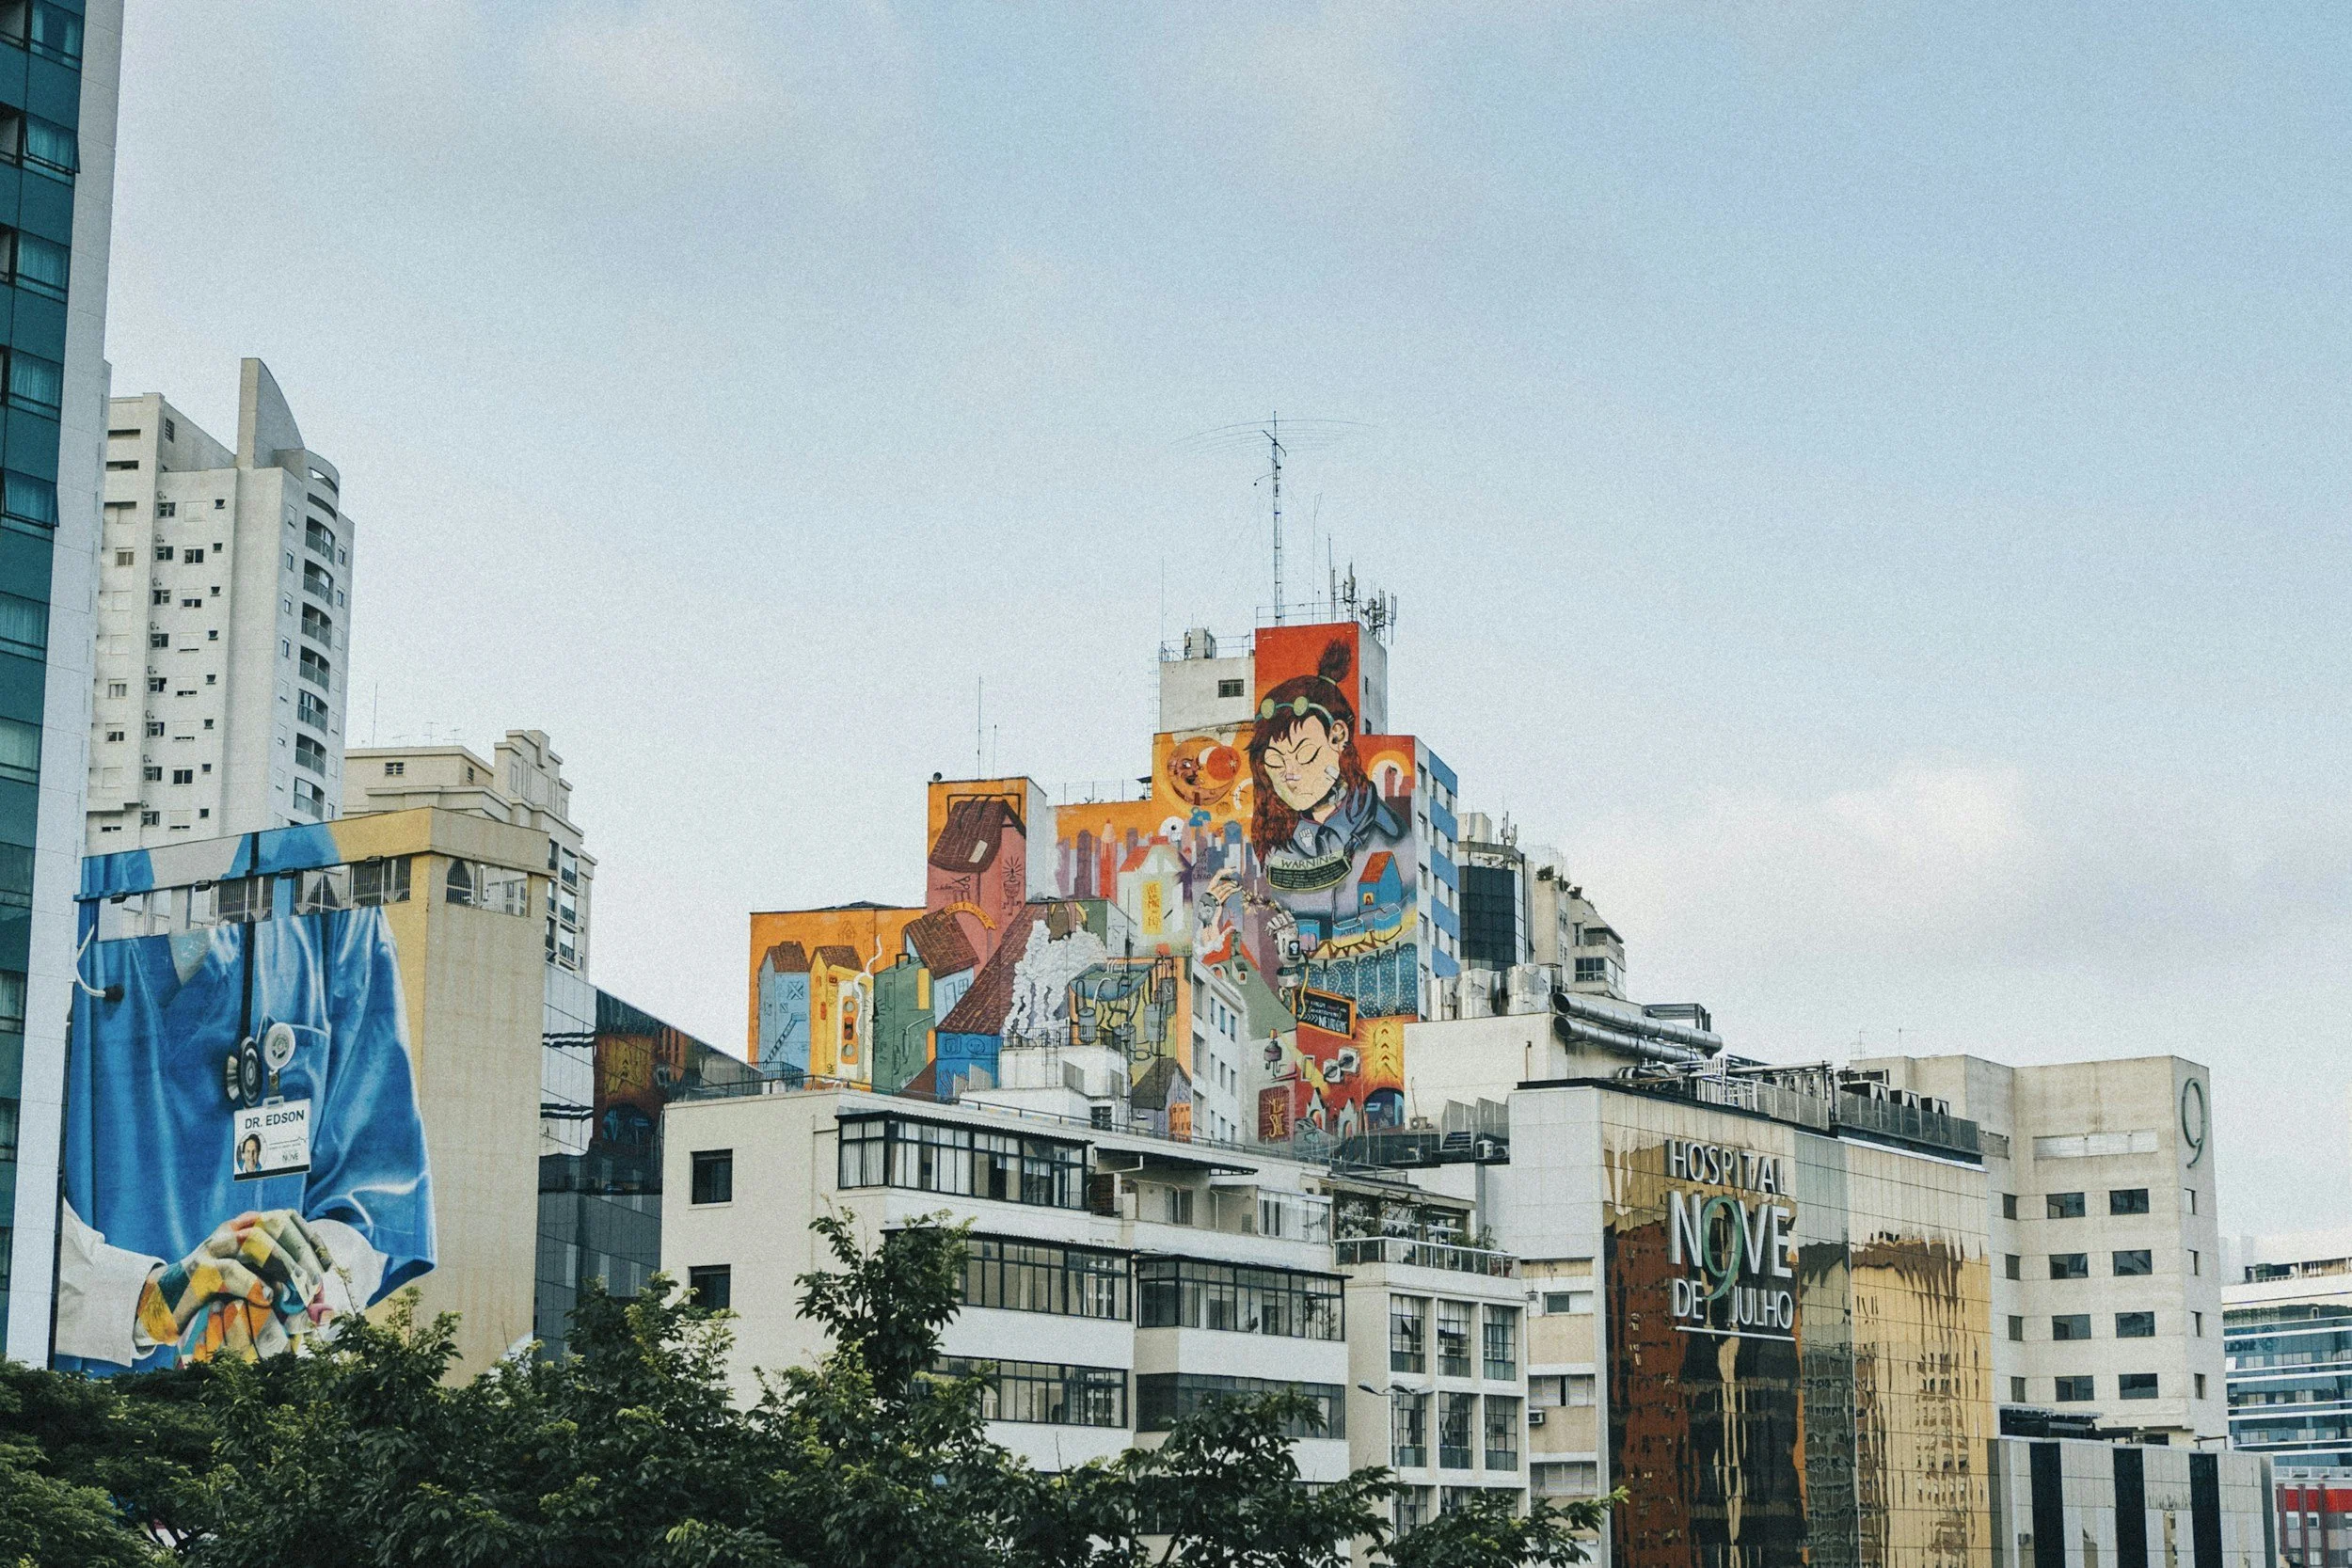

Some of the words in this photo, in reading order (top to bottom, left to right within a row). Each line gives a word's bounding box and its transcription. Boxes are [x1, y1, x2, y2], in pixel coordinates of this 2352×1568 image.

[1281, 854, 1337, 869] WARNING
[245, 1117, 262, 1129] DR.
[266, 1110, 305, 1126] EDSON
[2181, 1077, 2205, 1168] 9
[1664, 1139, 1786, 1195] HOSPITAL
[1669, 1277, 1704, 1320] DE
[1728, 1285, 1794, 1330] JULHO
